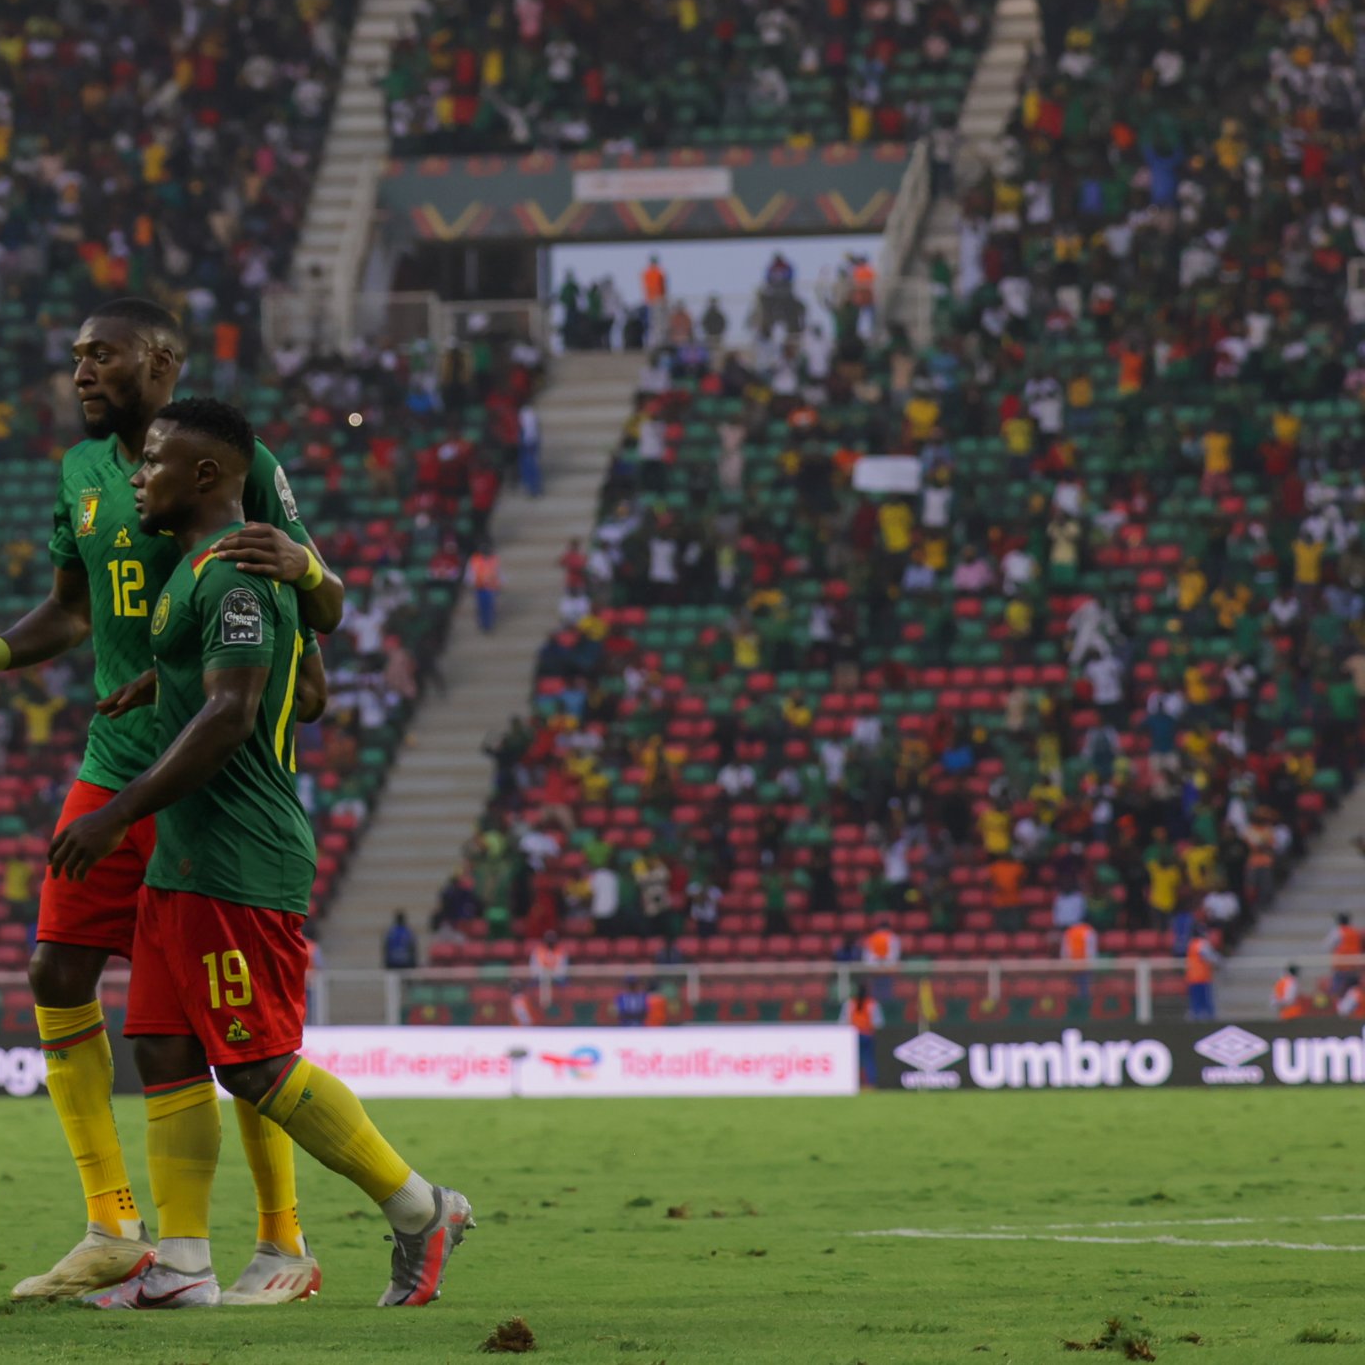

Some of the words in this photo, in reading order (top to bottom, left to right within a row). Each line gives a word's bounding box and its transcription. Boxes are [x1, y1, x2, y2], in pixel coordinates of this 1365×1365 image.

[107, 560, 148, 617] 12
[202, 949, 252, 1009] 19
[619, 1048, 831, 1084] TotalEnergies
[969, 1028, 1173, 1088] umbro
[1272, 1037, 1365, 1084] um
